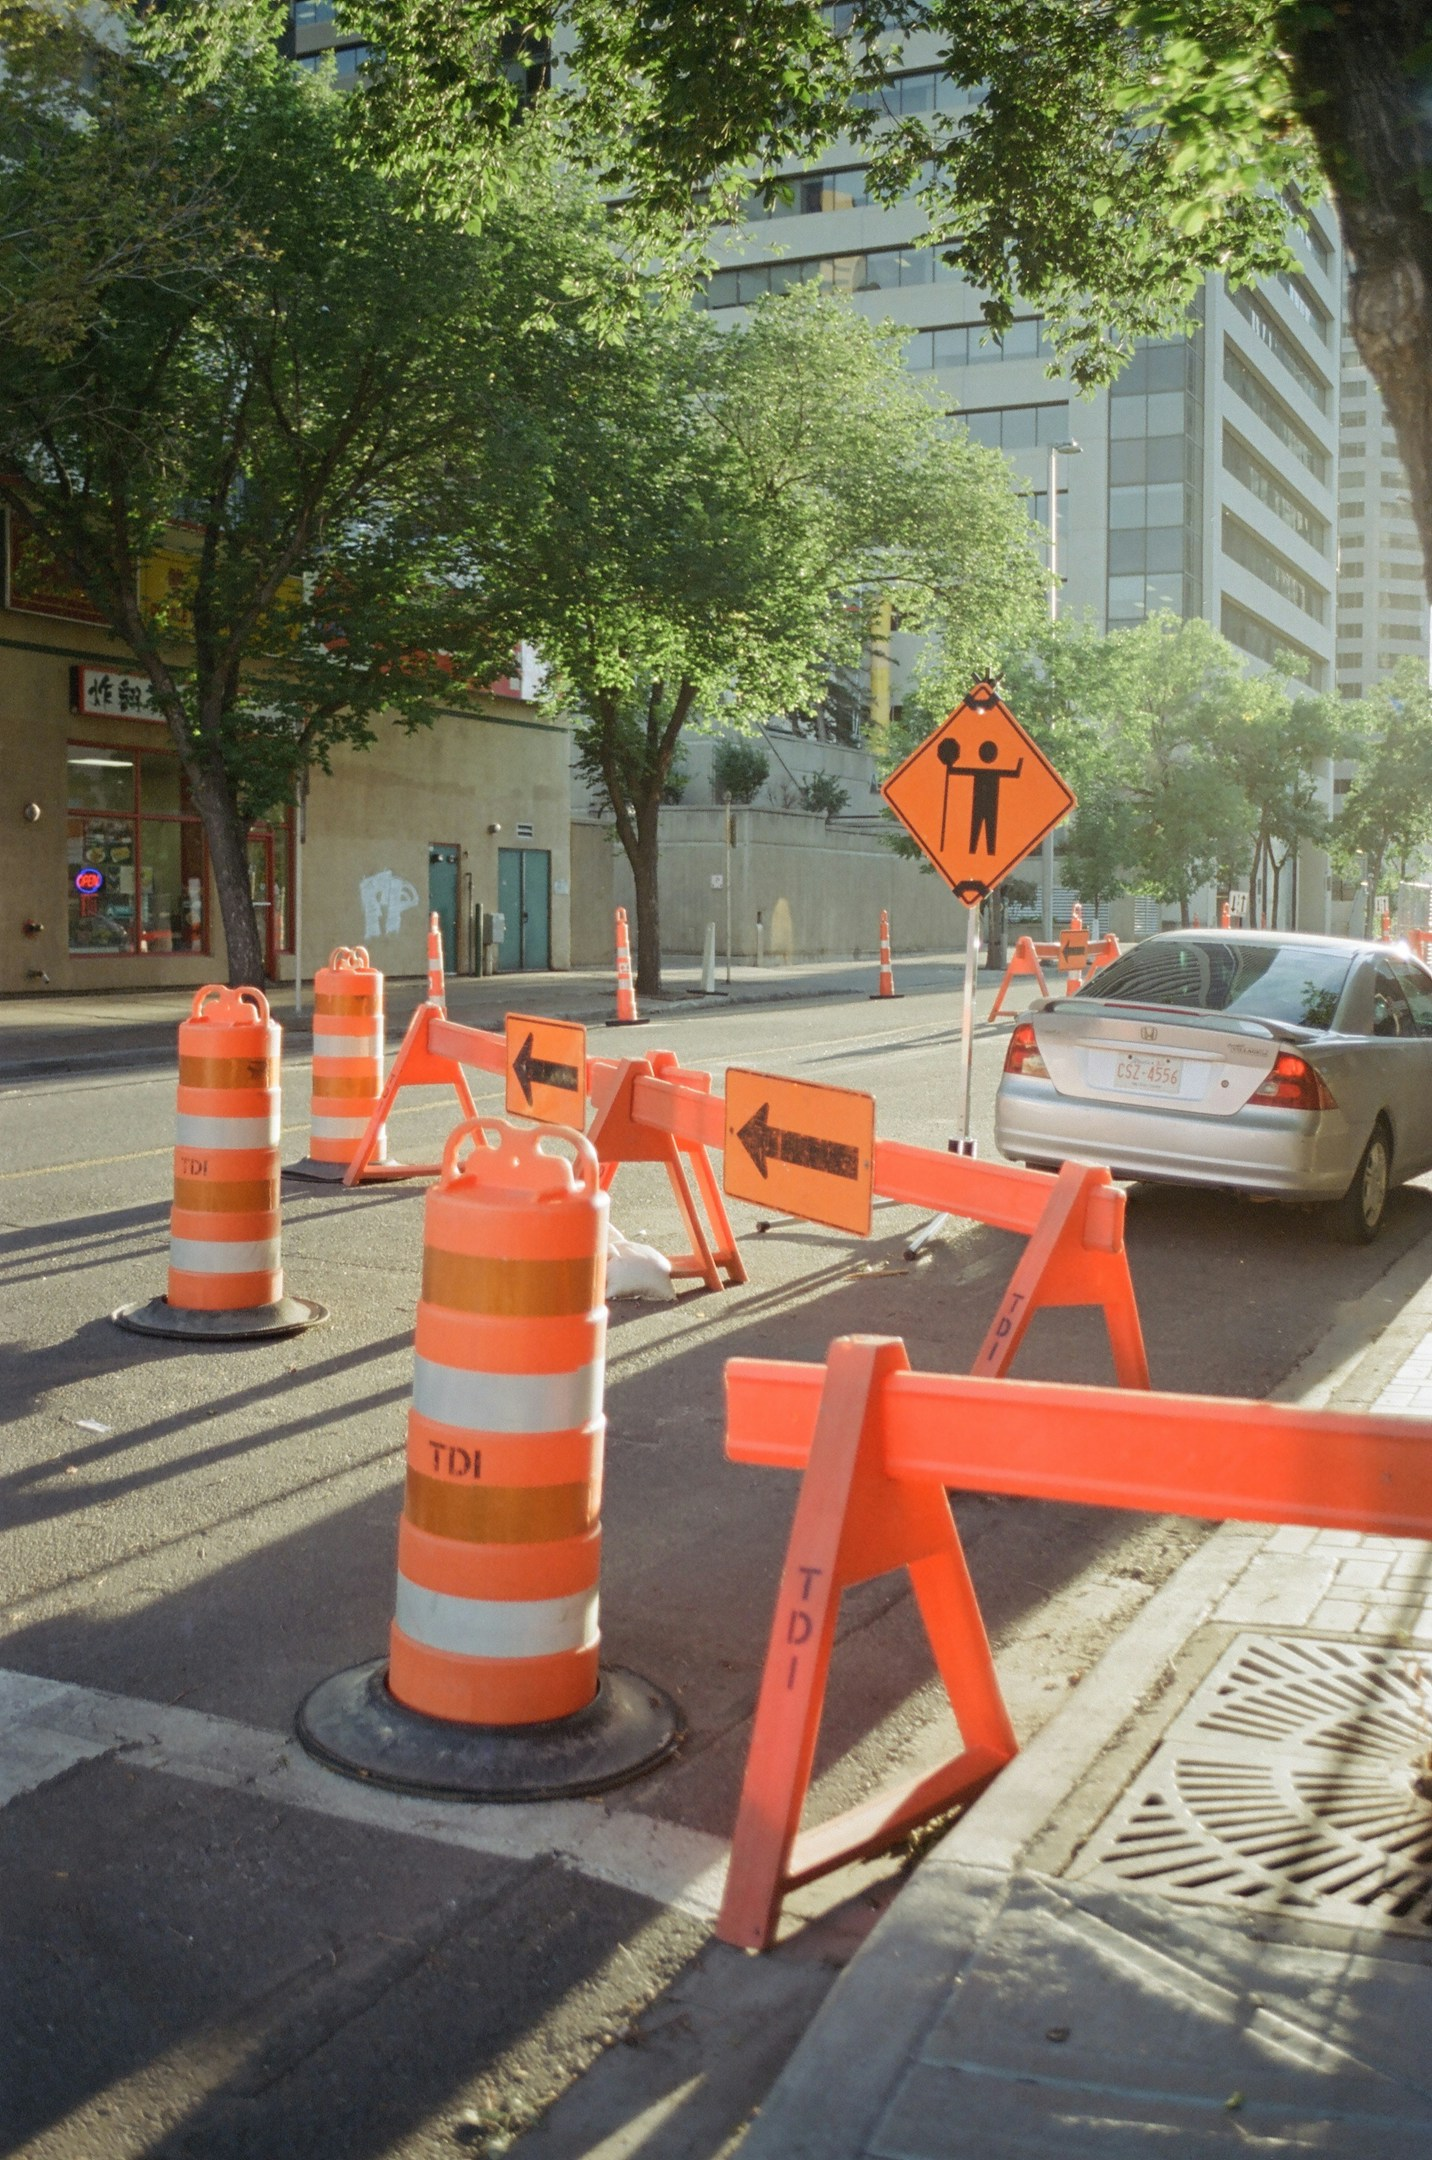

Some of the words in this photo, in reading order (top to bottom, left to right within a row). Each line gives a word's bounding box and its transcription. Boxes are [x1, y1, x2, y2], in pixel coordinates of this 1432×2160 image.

[181, 1156, 208, 1176] TDI
[987, 1292, 1025, 1361] TDI
[429, 1440, 482, 1479] TDI
[787, 1567, 823, 1690] TDI
